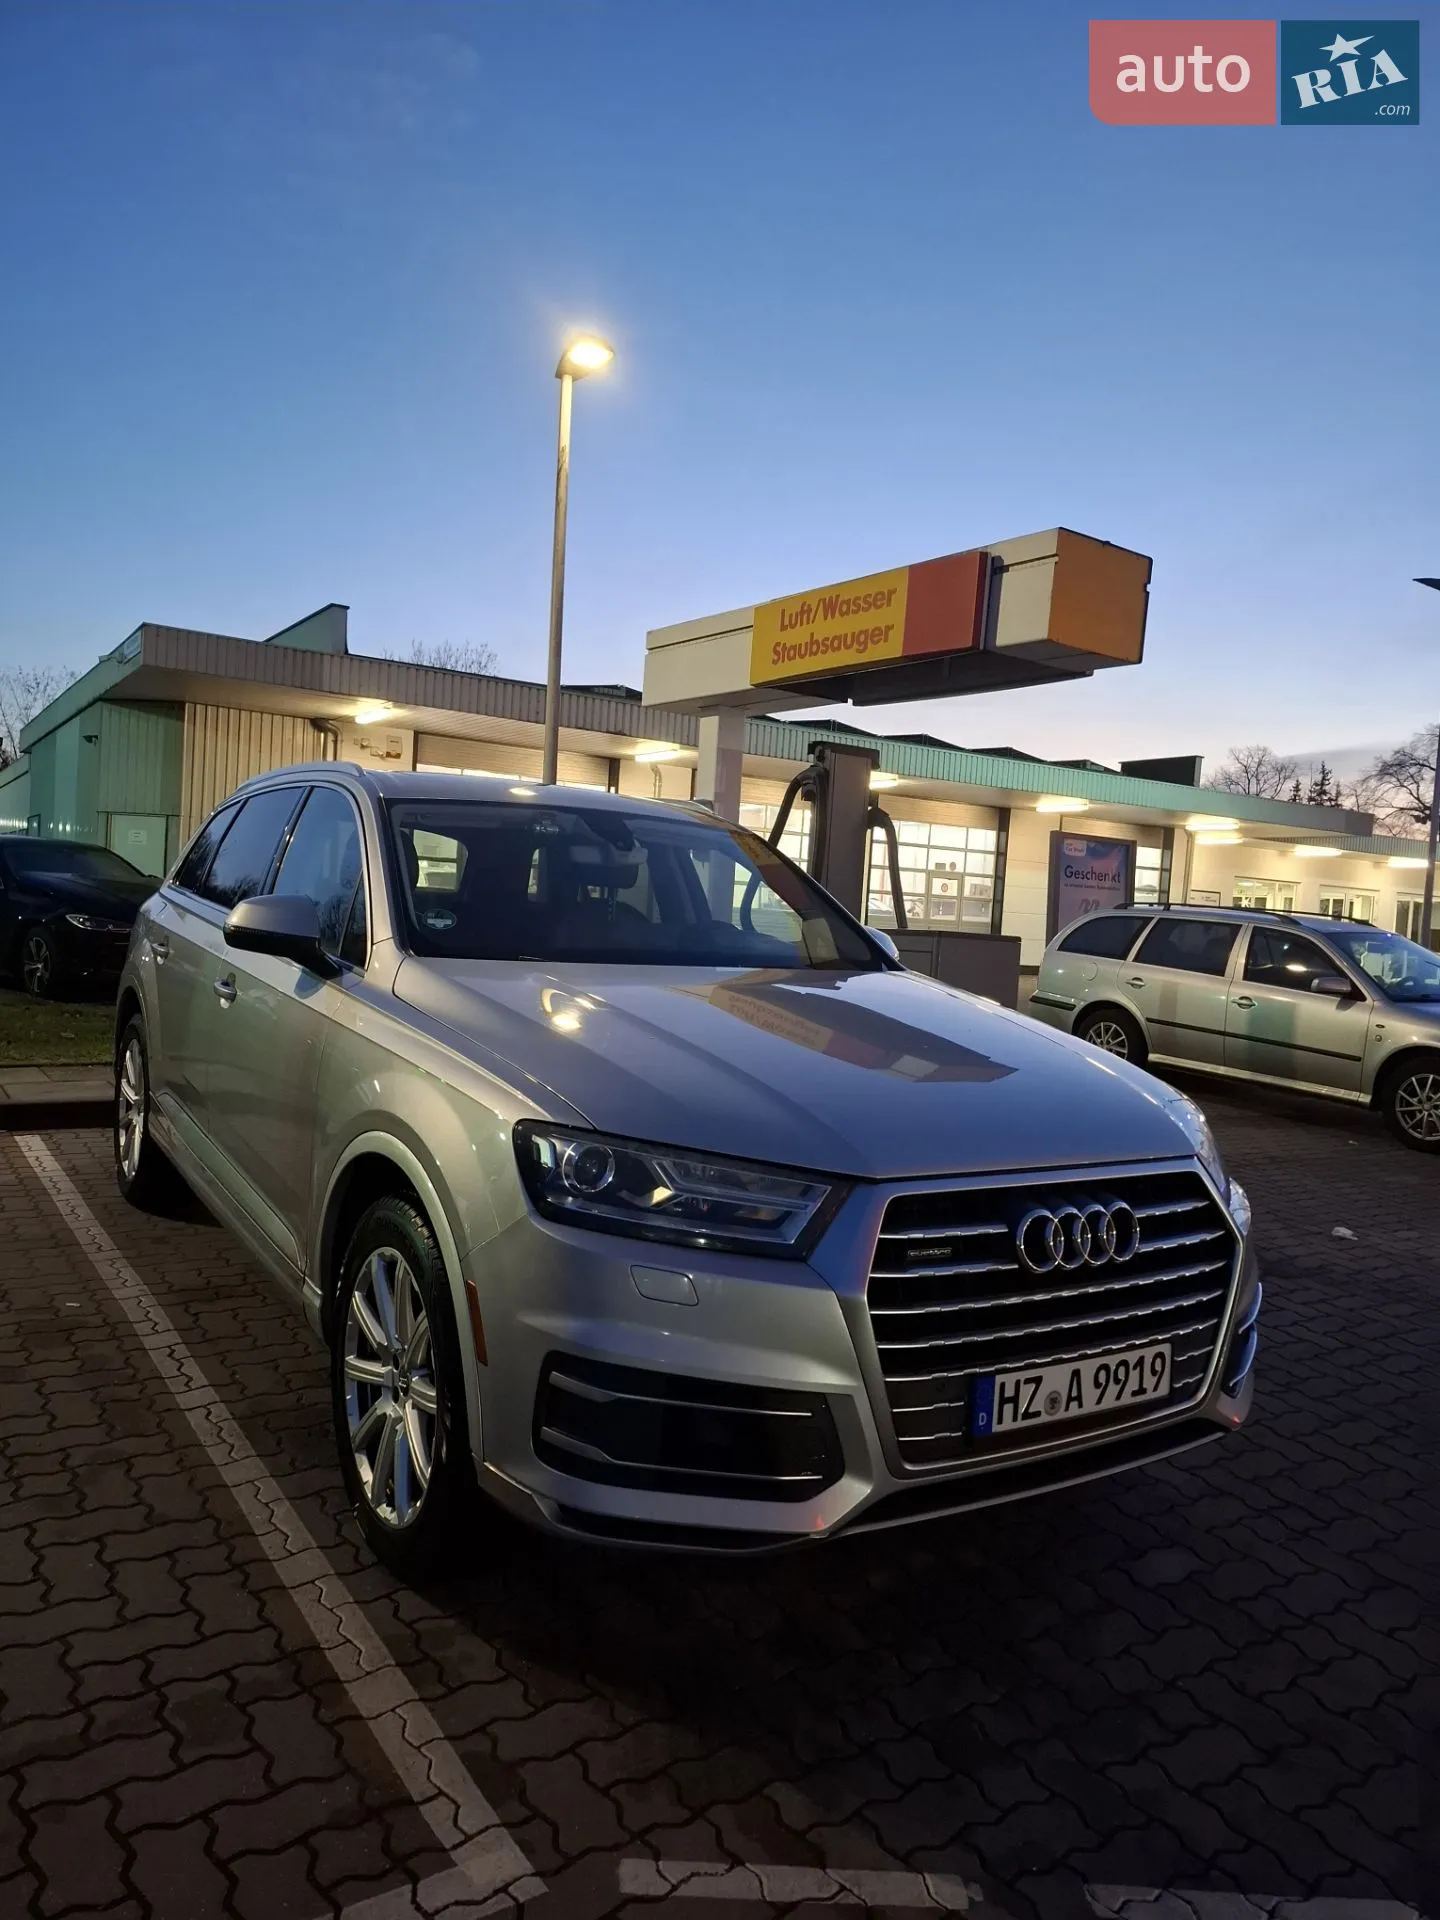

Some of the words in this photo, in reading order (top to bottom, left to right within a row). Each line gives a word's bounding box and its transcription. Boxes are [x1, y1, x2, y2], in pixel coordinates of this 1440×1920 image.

[779, 587, 898, 632] Luft/Wasser
[771, 623, 895, 666] Staubsauger
[996, 1375, 1044, 1425] HZ
[1064, 1368, 1084, 1412] A
[1093, 1351, 1167, 1406] 9919
[978, 1412, 987, 1425] D
